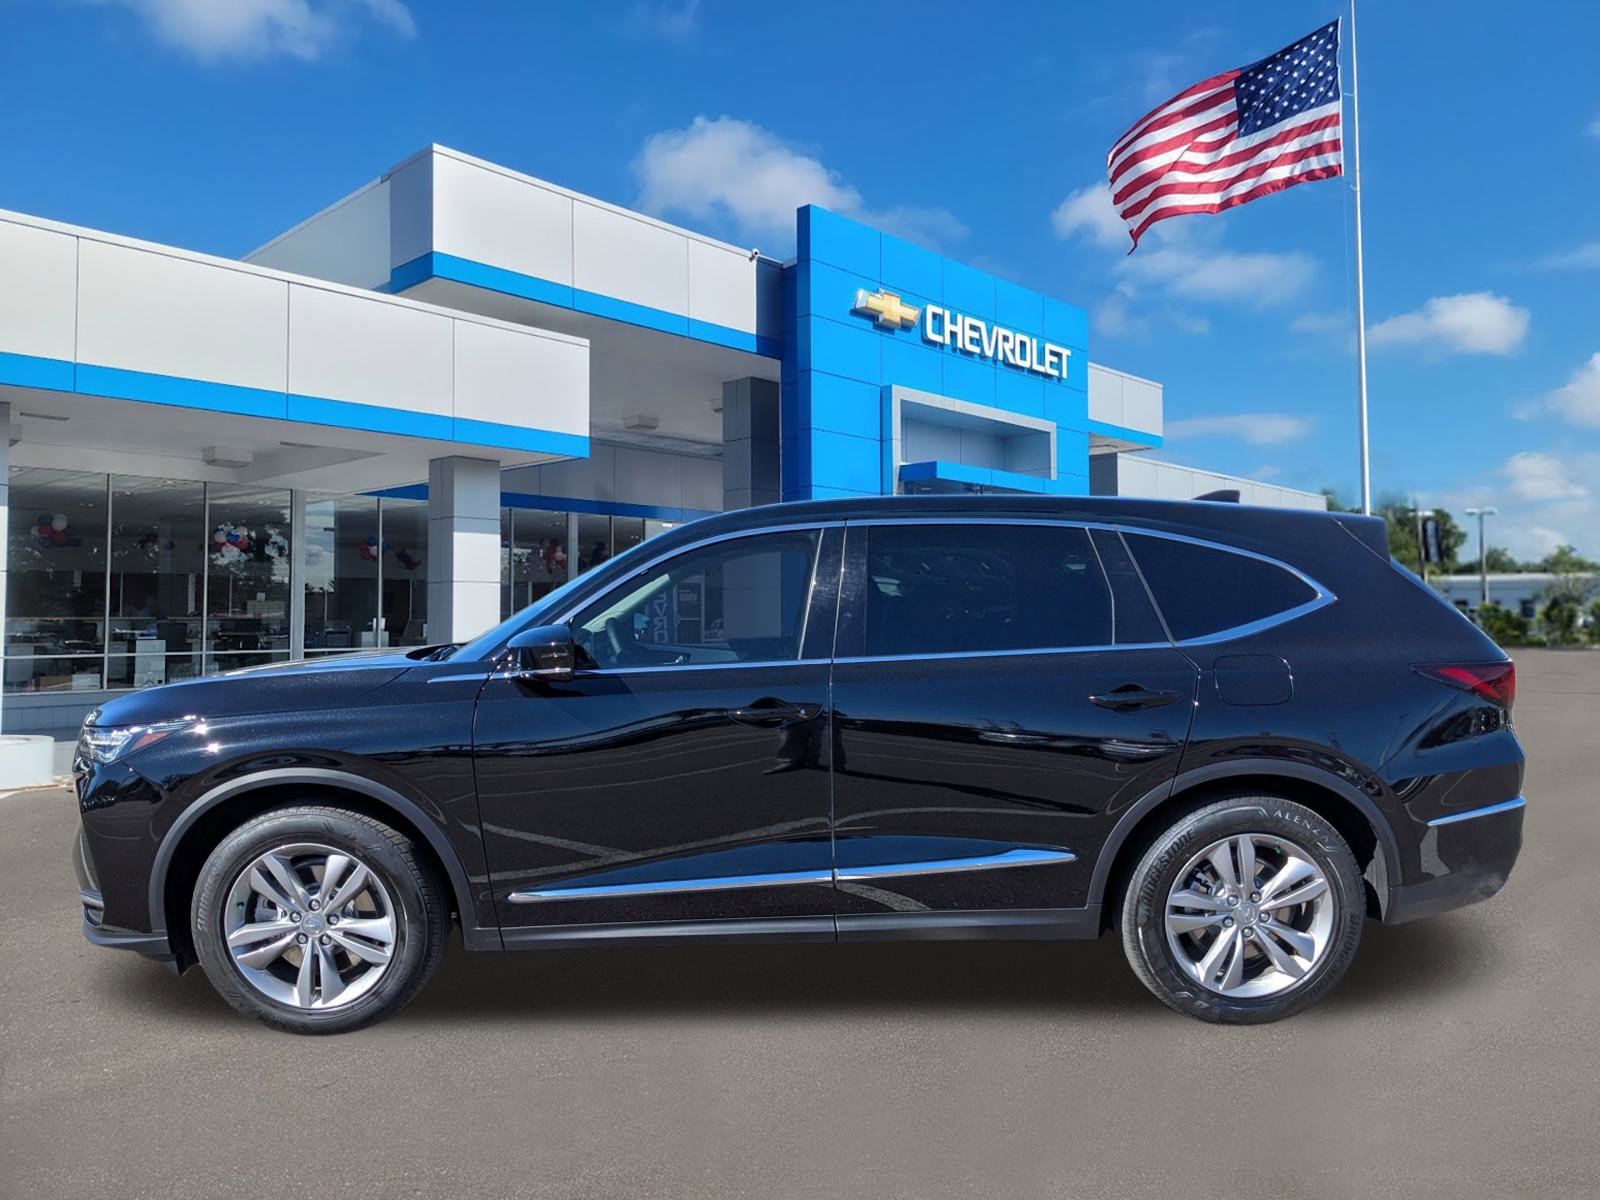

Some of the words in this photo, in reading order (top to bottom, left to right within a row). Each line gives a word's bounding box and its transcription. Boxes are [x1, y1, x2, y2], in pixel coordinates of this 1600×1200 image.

[925, 304, 1072, 379] CHEVROLET
[1273, 809, 1330, 844] ALENZA
[197, 840, 244, 932] BRIDGESE
[1141, 828, 1195, 920] BRIDGESTONE
